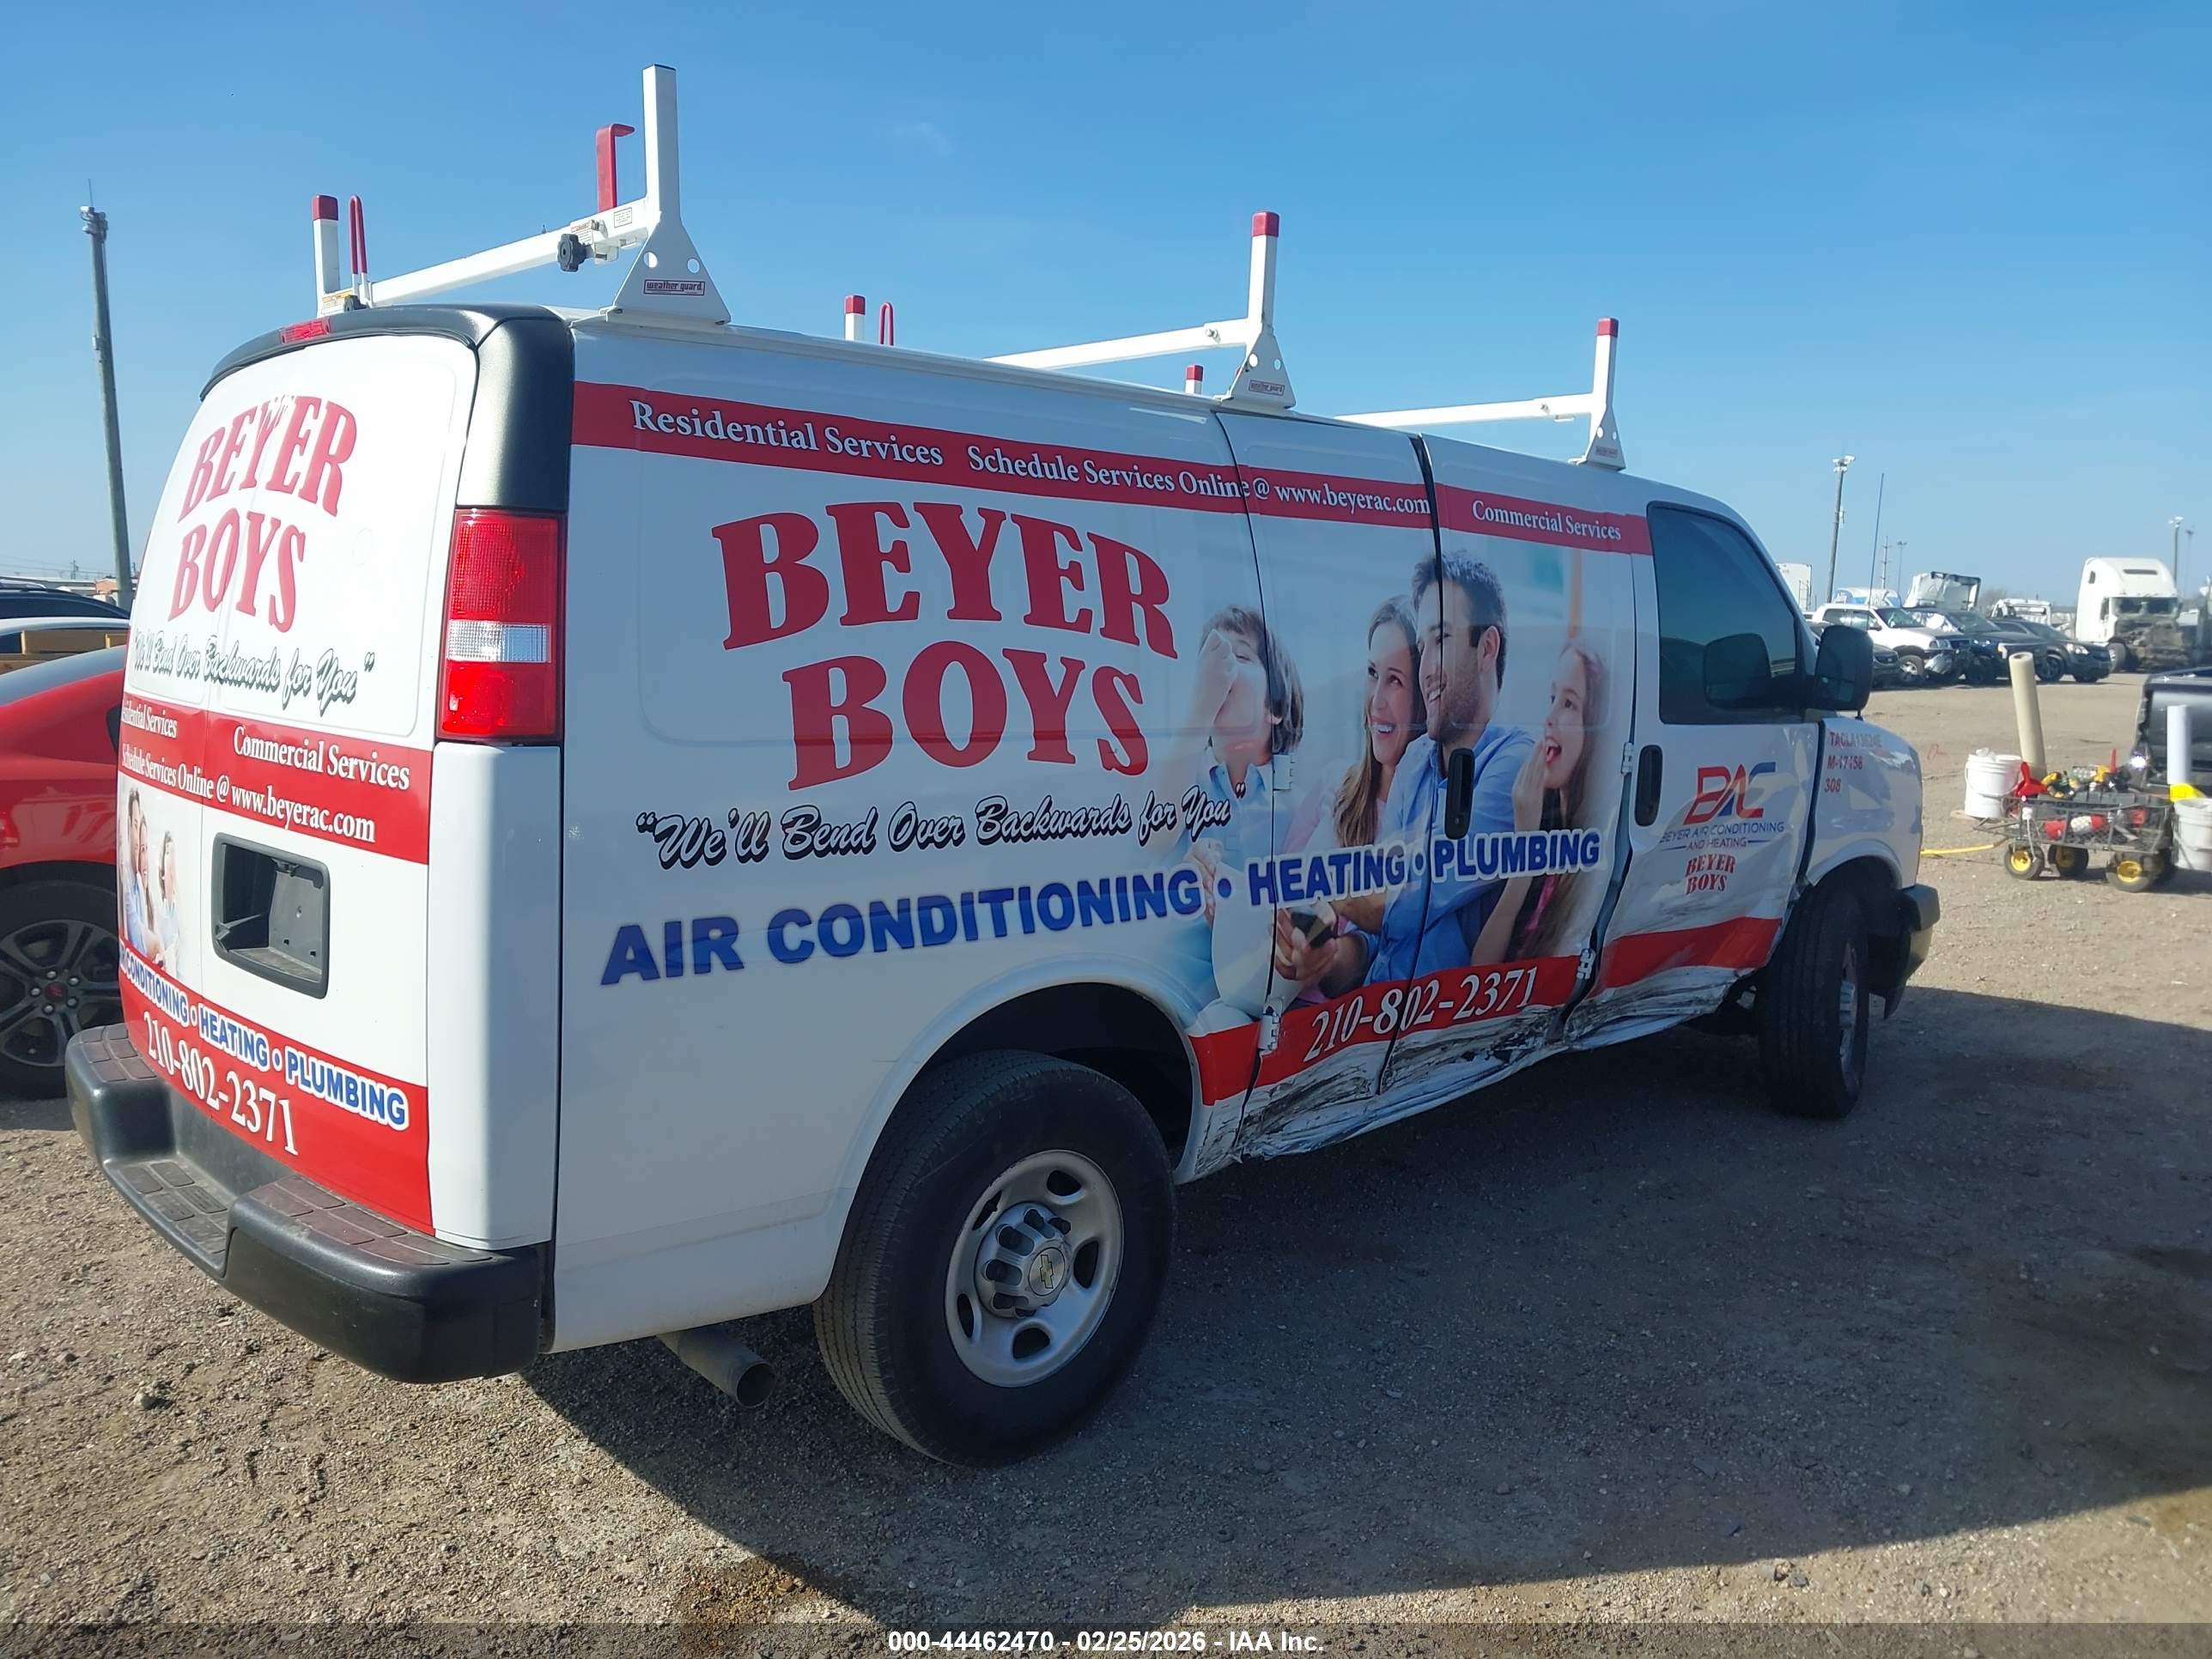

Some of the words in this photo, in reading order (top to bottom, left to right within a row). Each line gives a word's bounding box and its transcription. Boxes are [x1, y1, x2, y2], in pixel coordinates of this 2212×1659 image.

[647, 282, 678, 290] weather
[178, 395, 357, 524] BEYER
[629, 400, 819, 451] Residential
[824, 427, 944, 466] Services
[967, 445, 1079, 483] Schedule
[1083, 459, 1175, 492] Services
[1178, 470, 1250, 497] Online
[1253, 477, 1270, 500] @
[1274, 483, 1431, 514] www.beyerac.com
[1472, 500, 1563, 533] Commercial
[1565, 515, 1622, 541] Services
[168, 507, 306, 633] BOYS
[711, 501, 1177, 659] BEYER
[204, 635, 281, 692] Backwards
[283, 647, 312, 710] for
[145, 706, 178, 738] Services
[234, 726, 324, 773] Commercial
[327, 744, 410, 790] Services
[782, 641, 1149, 791] BOYS
[145, 752, 177, 787] Services
[178, 763, 214, 799] Online
[216, 775, 230, 803] @
[231, 785, 376, 843] www.beyerac.com
[636, 807, 771, 870] “We’ll
[781, 805, 879, 860] Bend
[888, 801, 965, 852] Over
[975, 794, 1132, 846] Backwards
[1139, 790, 1177, 846] for
[1692, 825, 1710, 839] AIR
[1711, 822, 1785, 836] CONDITIONING
[1685, 853, 1736, 878] BEYER
[1686, 839, 1706, 851] AND
[1707, 837, 1747, 849] HEATING
[1686, 873, 1728, 895] BOYS
[600, 915, 745, 986] AIR
[768, 869, 1201, 964] CONDITIONING
[1249, 849, 1405, 905] HEATING
[1434, 831, 1600, 878] PLUMBING
[126, 950, 189, 1025] CONDITIONING
[200, 1006, 268, 1067] HEATING
[288, 1049, 406, 1126] PLUMBING
[1304, 966, 1539, 1063] 210-802-2371
[144, 1011, 299, 1156] 210-802-2371
